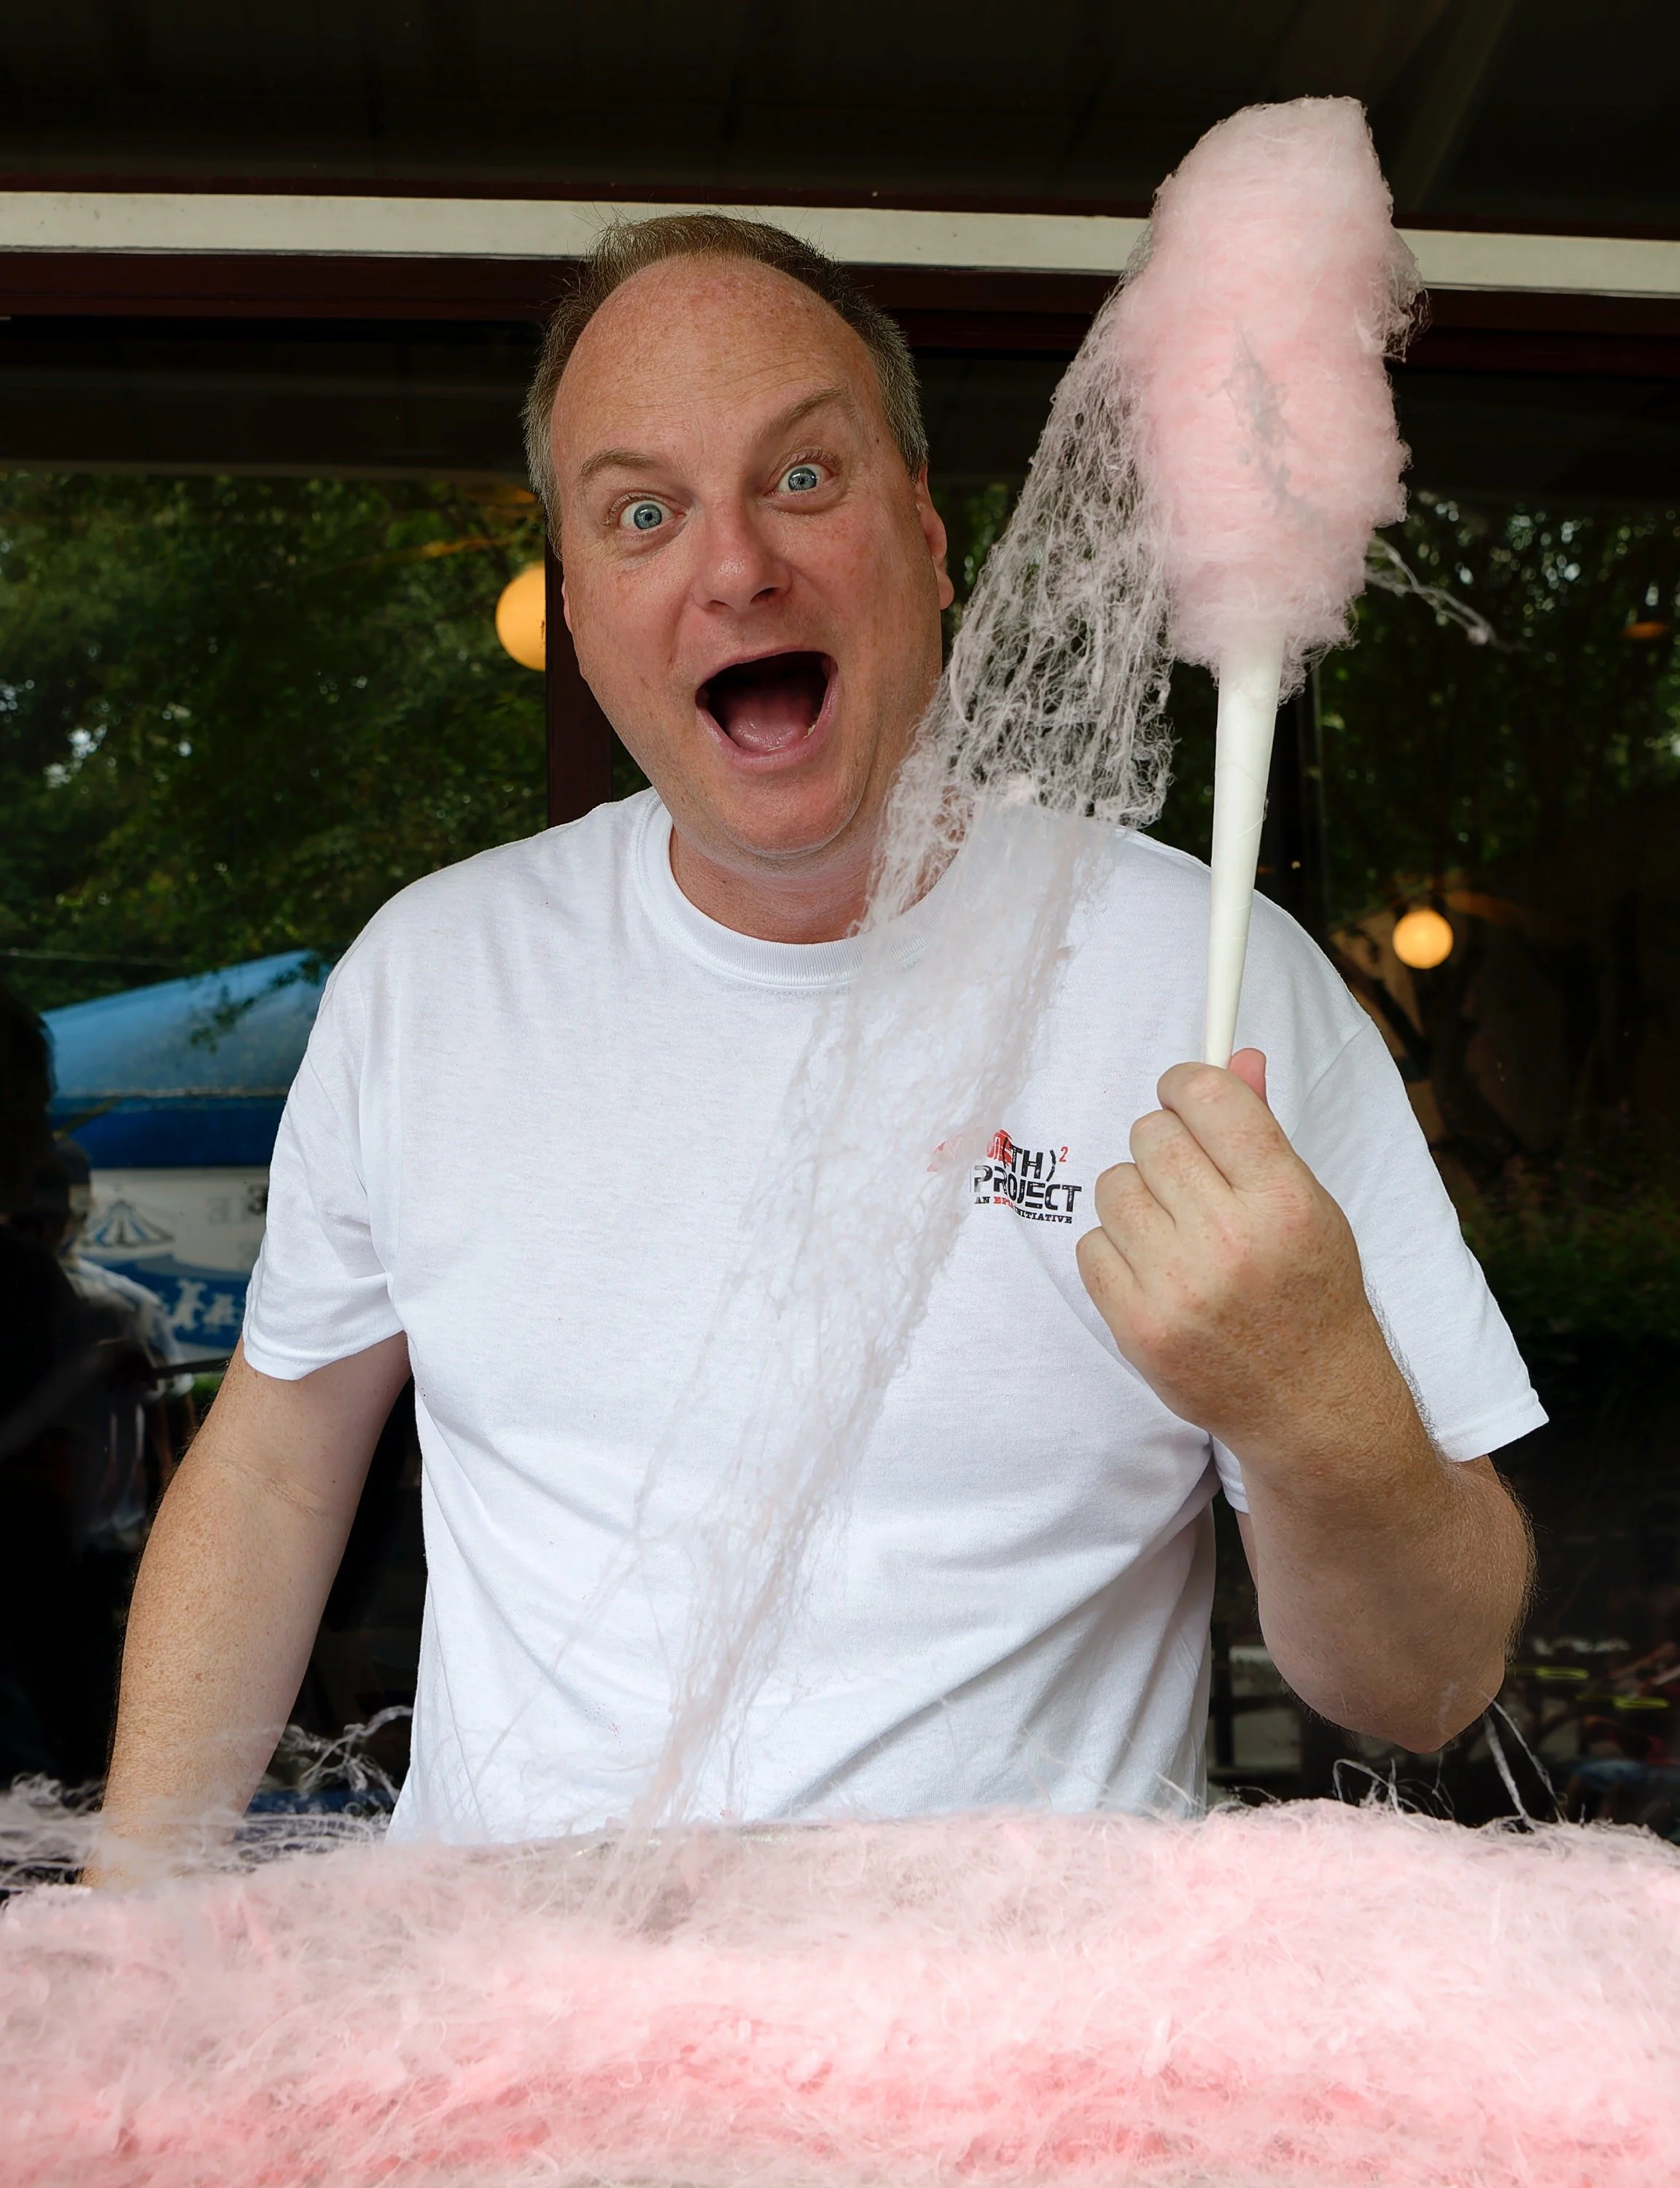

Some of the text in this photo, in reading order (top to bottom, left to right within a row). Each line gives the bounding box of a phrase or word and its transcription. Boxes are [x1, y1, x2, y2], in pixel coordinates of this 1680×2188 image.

[973, 1165, 1082, 1212] PROJECT
[974, 1196, 991, 1204] AN
[1014, 1206, 1073, 1224] INITIATIVE
